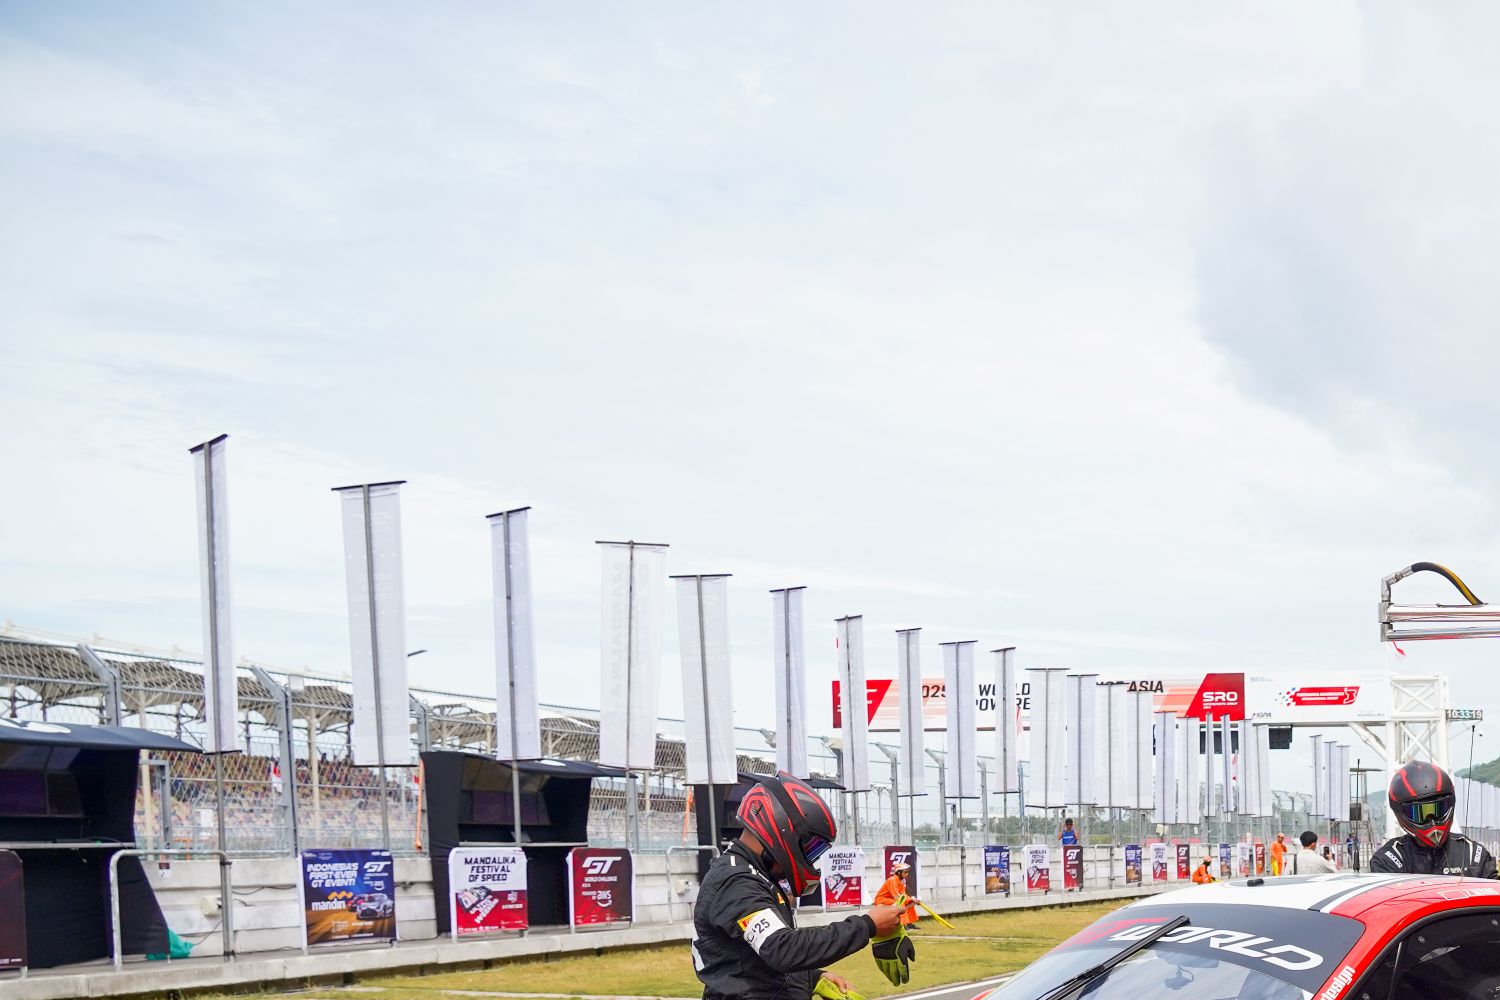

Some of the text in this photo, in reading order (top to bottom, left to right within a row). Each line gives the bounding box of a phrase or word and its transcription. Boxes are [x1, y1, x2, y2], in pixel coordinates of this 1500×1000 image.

[1127, 681, 1164, 693] ASIA
[1202, 692, 1238, 702] SRO
[464, 856, 516, 866] MANDALIKA
[582, 856, 622, 875] GT
[307, 863, 359, 872] INDONESIA'S
[471, 865, 511, 873] FESTIVAL
[309, 871, 357, 880] FIRST-EVER
[468, 873, 508, 882] OF SPEED
[312, 878, 356, 888] GT EVENT!
[597, 890, 612, 900] aws
[312, 898, 346, 911] mandiri
[1108, 925, 1324, 971] WORLD
